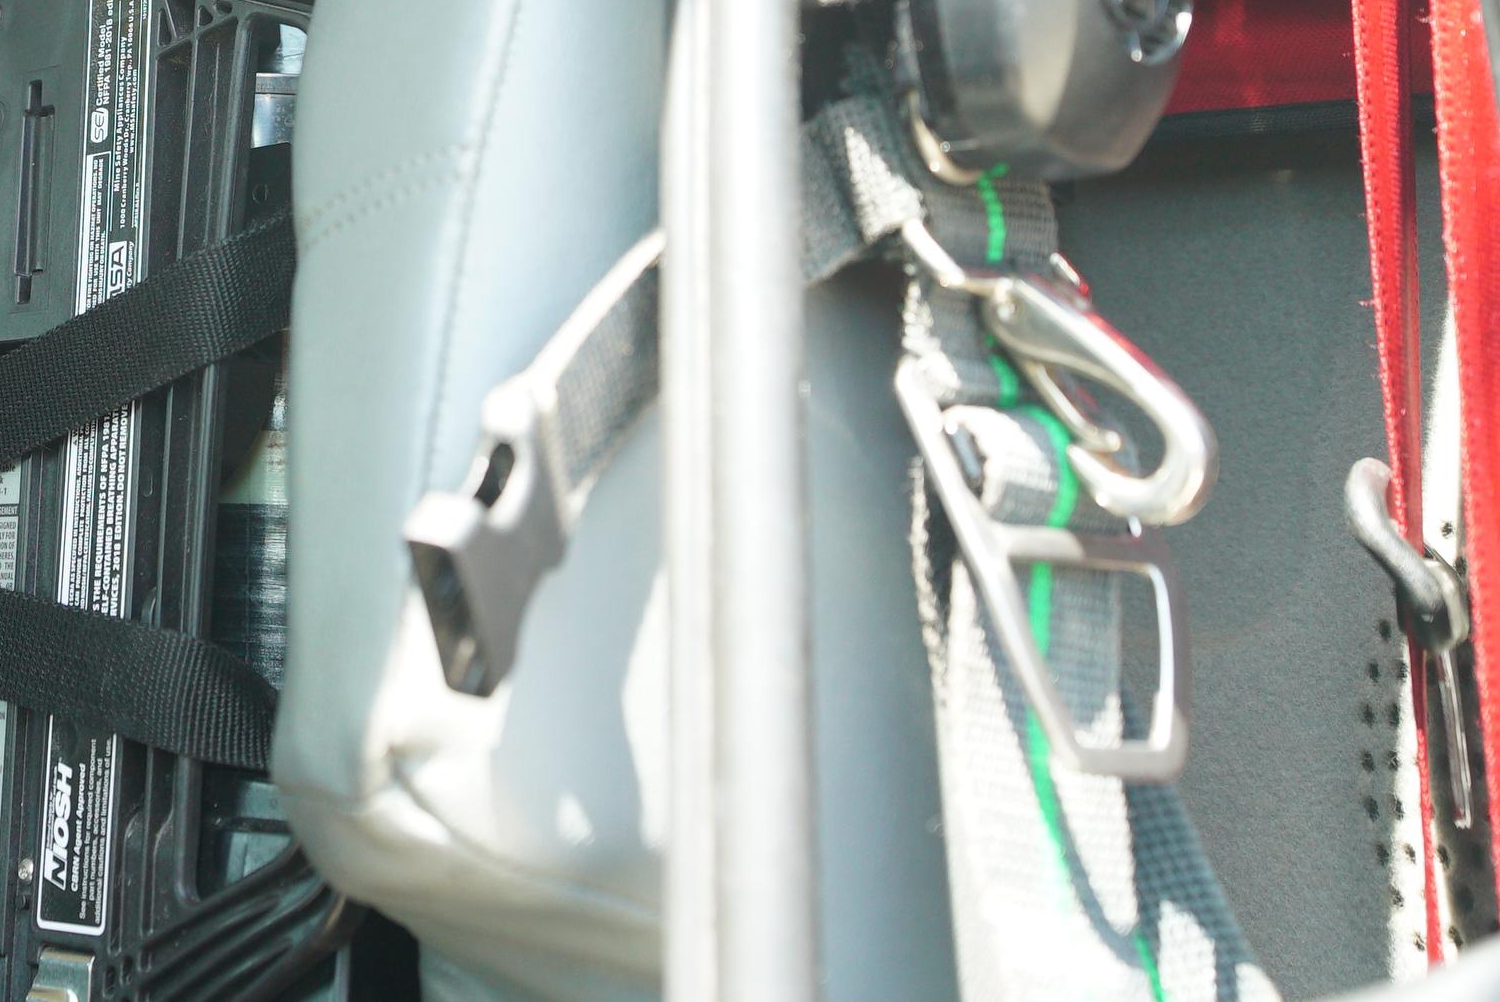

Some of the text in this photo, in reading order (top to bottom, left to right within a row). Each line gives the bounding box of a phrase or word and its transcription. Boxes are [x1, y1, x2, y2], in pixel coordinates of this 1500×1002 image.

[96, 24, 106, 106] Certified Model
[103, 18, 113, 72] 1981-2018
[127, 48, 132, 58] PA
[91, 105, 108, 143] SEI
[113, 36, 127, 191] Mine Safety Appliances Company
[124, 80, 132, 122] Cranberry
[100, 475, 107, 490] OF
[101, 444, 109, 472] NFPA
[106, 462, 117, 524] BREATHING
[113, 405, 128, 570] 2018 EDITION. DO NOT REMOVE
[94, 492, 106, 577] REQUIREMENTS
[93, 579, 101, 601] THE
[101, 526, 113, 614] ELF-CONTAINED
[104, 758, 110, 768] of
[100, 769, 109, 816] limitations
[44, 761, 72, 890] NIOSH
[71, 763, 86, 892] CBRN Agent Approved
[81, 845, 90, 899] instructions
[94, 878, 102, 924] additional
